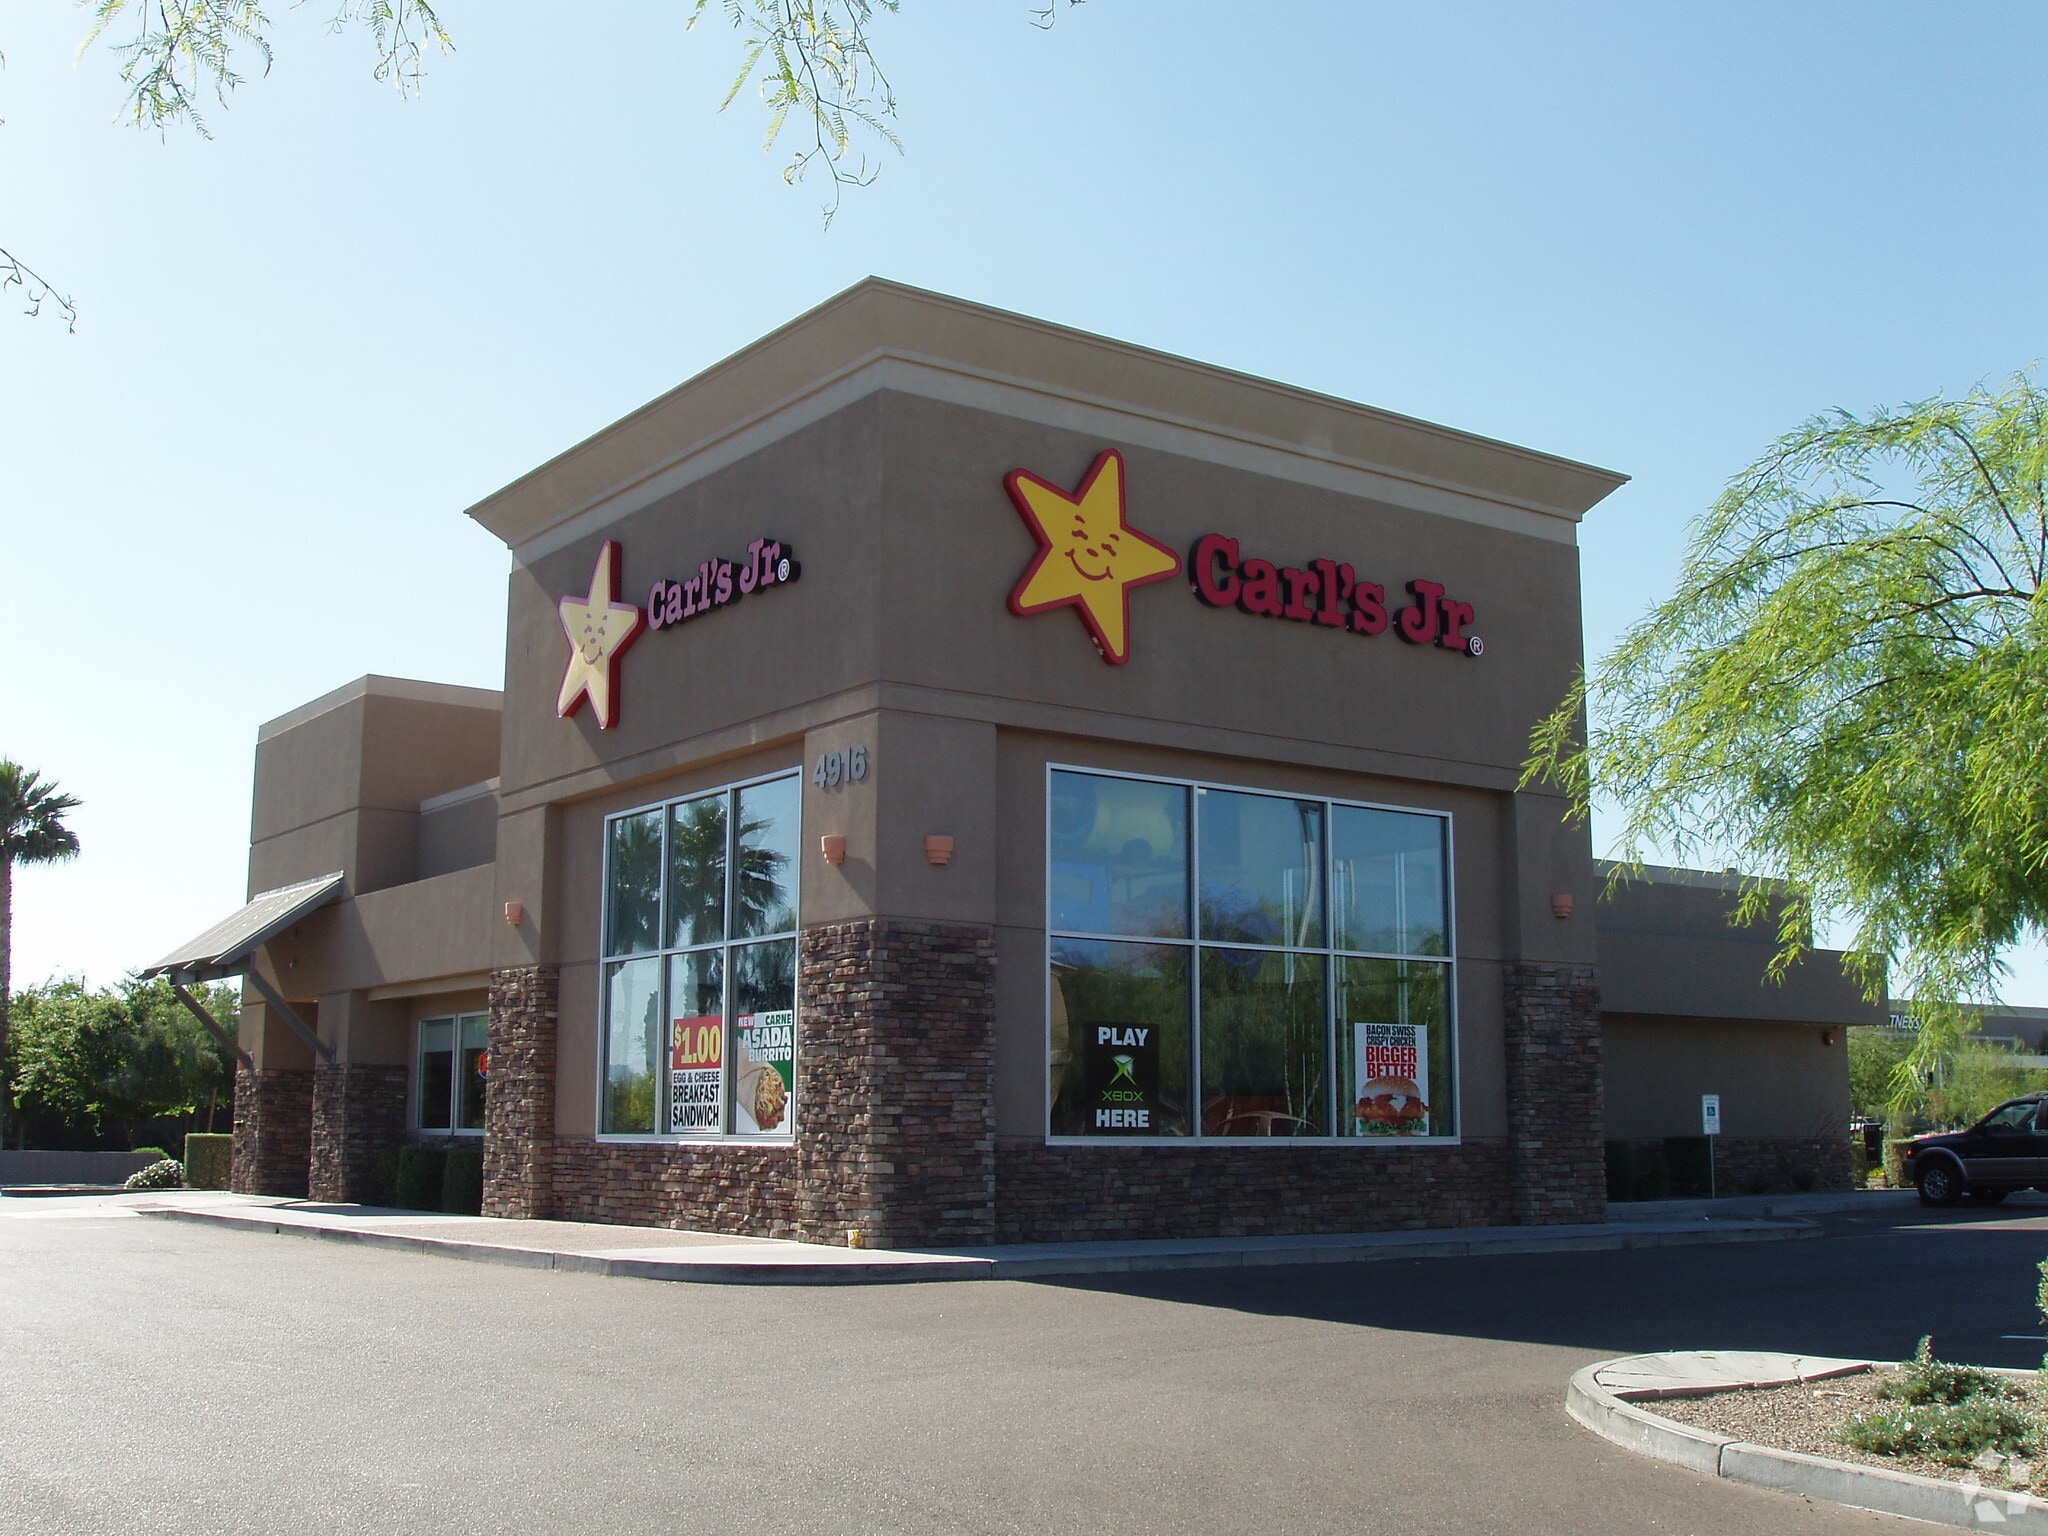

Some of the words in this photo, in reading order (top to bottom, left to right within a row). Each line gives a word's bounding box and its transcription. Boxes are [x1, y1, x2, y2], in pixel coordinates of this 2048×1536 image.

[1189, 533, 1388, 635] Carl's
[648, 557, 734, 631] Carl's
[813, 744, 867, 788] 4916
[737, 1016, 754, 1027] NEW
[765, 1013, 792, 1026] CARNE
[741, 1026, 792, 1049] ASADA
[1098, 1026, 1148, 1047] PLAY
[1366, 1024, 1390, 1036] BACON
[1391, 1025, 1416, 1036] SWISS
[674, 1024, 721, 1064] $1.00
[1366, 1035, 1389, 1046] CRISPY
[1390, 1036, 1416, 1047] CHICKEN
[748, 1047, 792, 1062] BURRITO
[1366, 1046, 1417, 1063] BIGGER
[673, 1072, 686, 1083] EGG
[687, 1072, 693, 1083] &
[694, 1071, 720, 1083] CHEESE
[1367, 1062, 1416, 1079] BETTER
[673, 1083, 720, 1103] BREAKFAST
[1102, 1090, 1143, 1102] XBOX
[672, 1104, 719, 1127] SANDWICH
[1096, 1109, 1149, 1127] HERE
